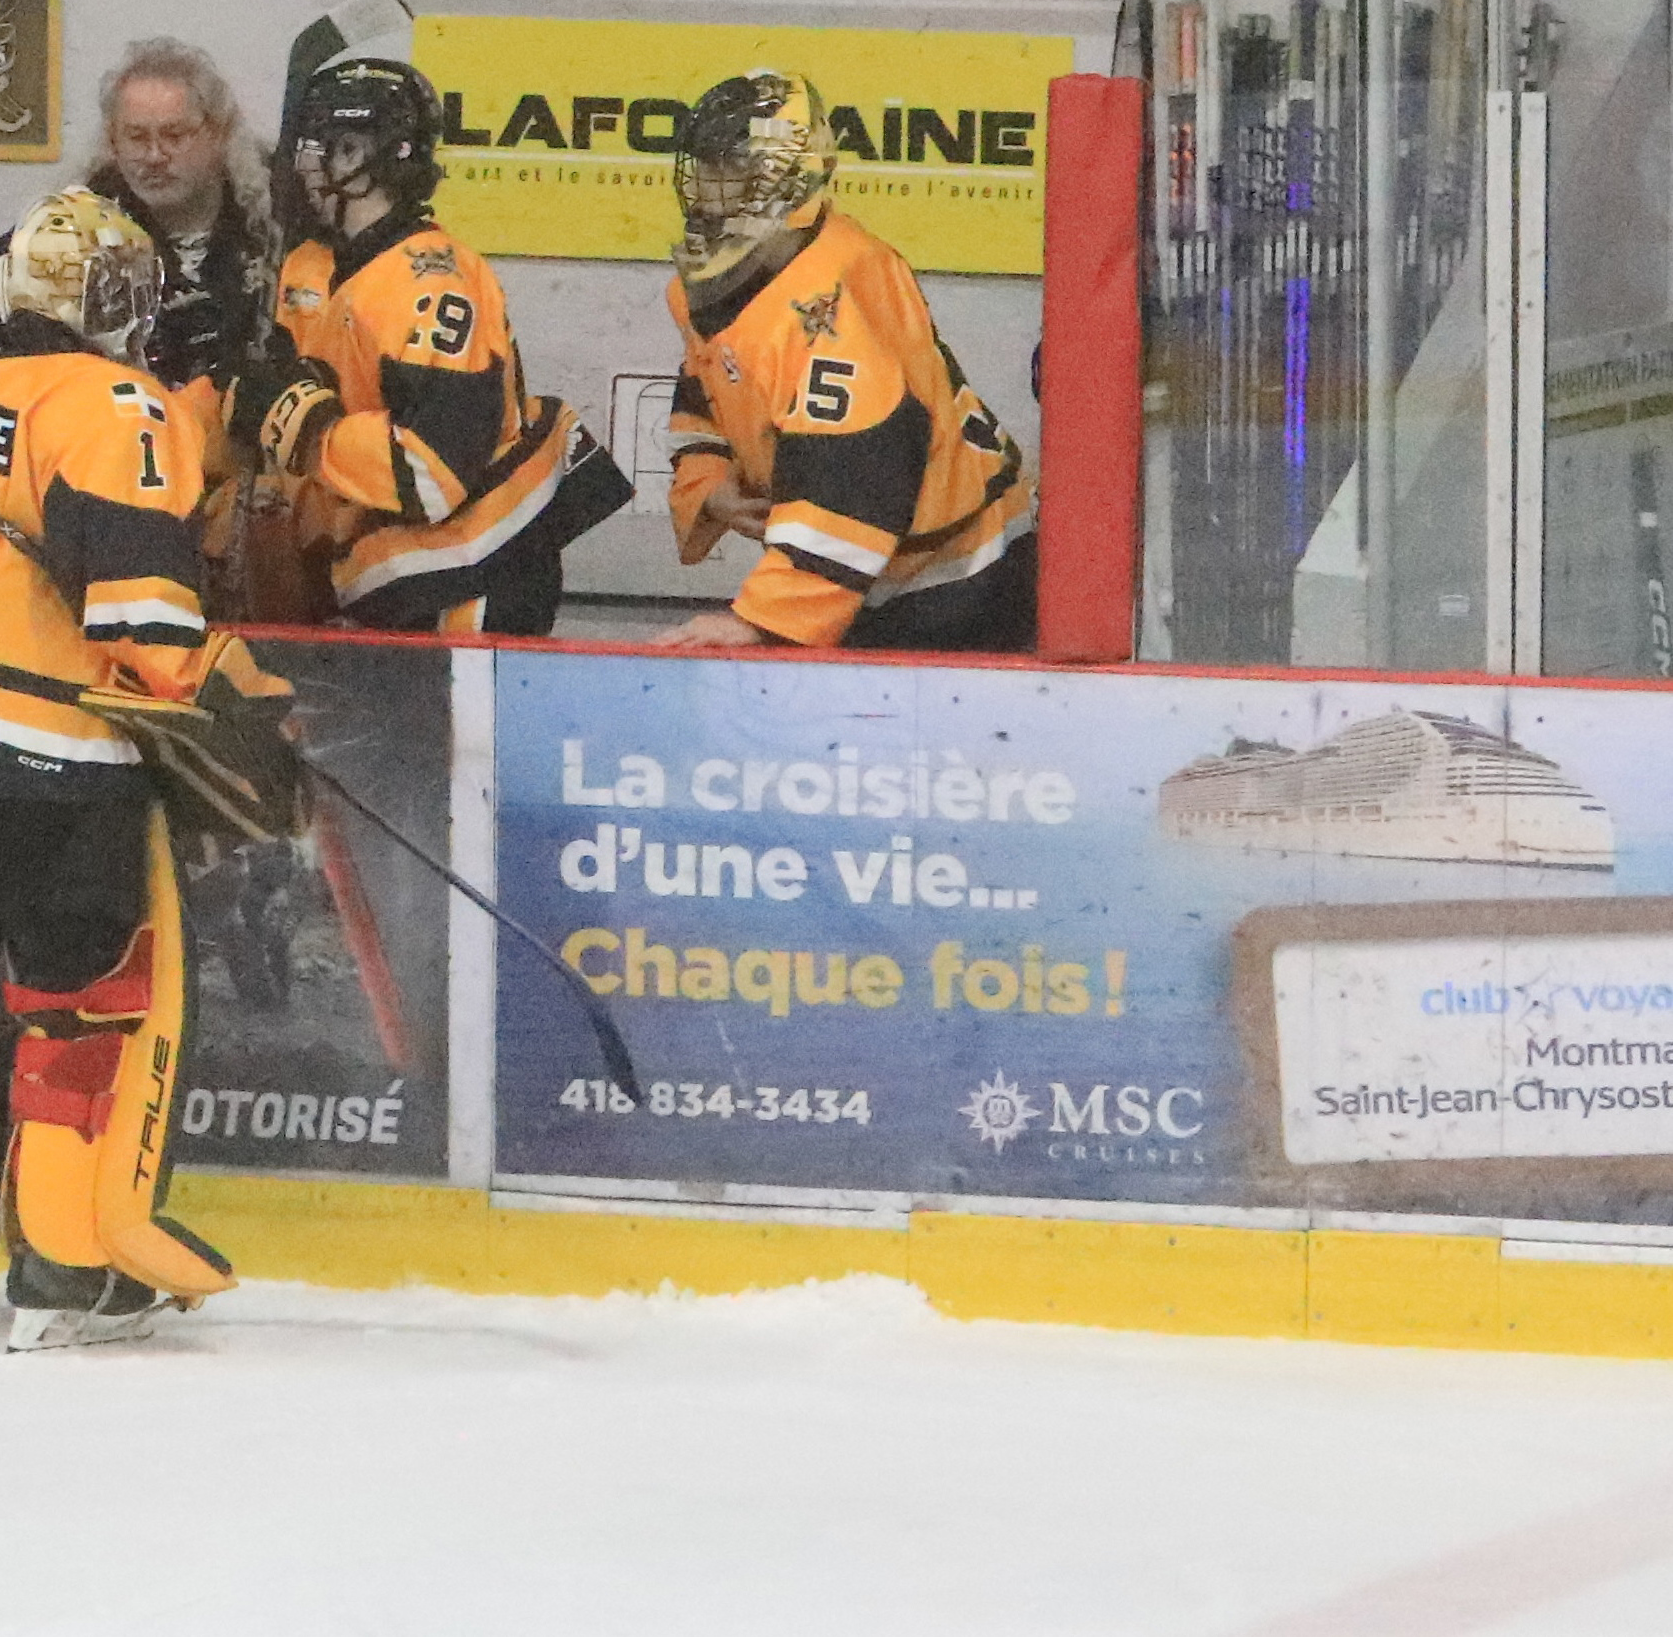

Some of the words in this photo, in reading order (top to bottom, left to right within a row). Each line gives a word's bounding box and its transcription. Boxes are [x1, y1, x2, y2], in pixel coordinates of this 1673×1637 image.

[333, 108, 372, 118] CCM
[595, 172, 667, 188] savoi
[927, 179, 1036, 201] l'avenir
[137, 429, 167, 491] 1
[16, 754, 63, 773] CCM
[561, 738, 666, 810] La
[690, 745, 1077, 825] croisière
[559, 822, 809, 902] d'une
[559, 927, 905, 1018] Chaque
[1420, 980, 1510, 1015] club
[133, 1033, 172, 1192] TRUE
[181, 1077, 404, 1145] OTORISÉ
[648, 1082, 873, 1127] 834-3434
[1047, 1081, 1204, 1139] MSC
[1047, 1143, 1204, 1165] CRUISES
